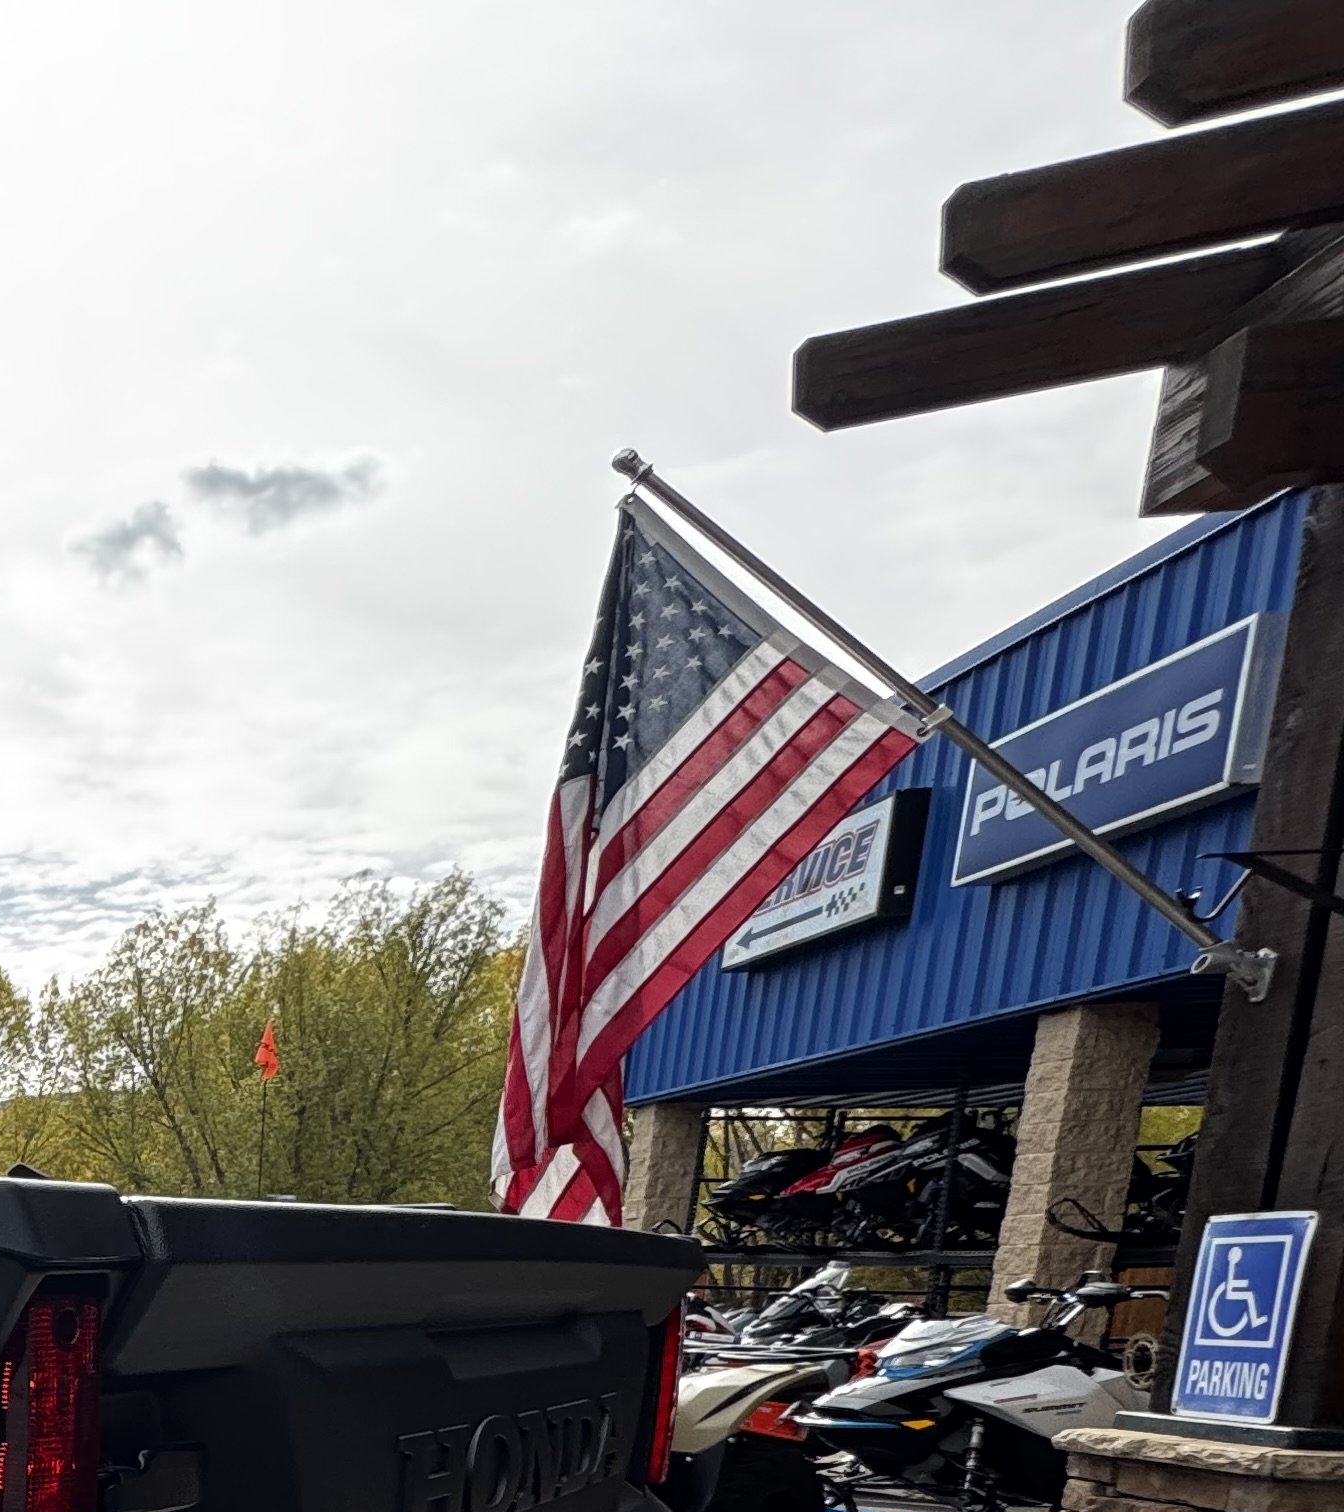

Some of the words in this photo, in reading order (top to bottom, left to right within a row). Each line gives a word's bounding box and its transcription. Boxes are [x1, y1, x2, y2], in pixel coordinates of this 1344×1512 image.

[970, 688, 1223, 836] POLARIS
[752, 818, 880, 918] RVICE
[1184, 1359, 1270, 1400] PARKING
